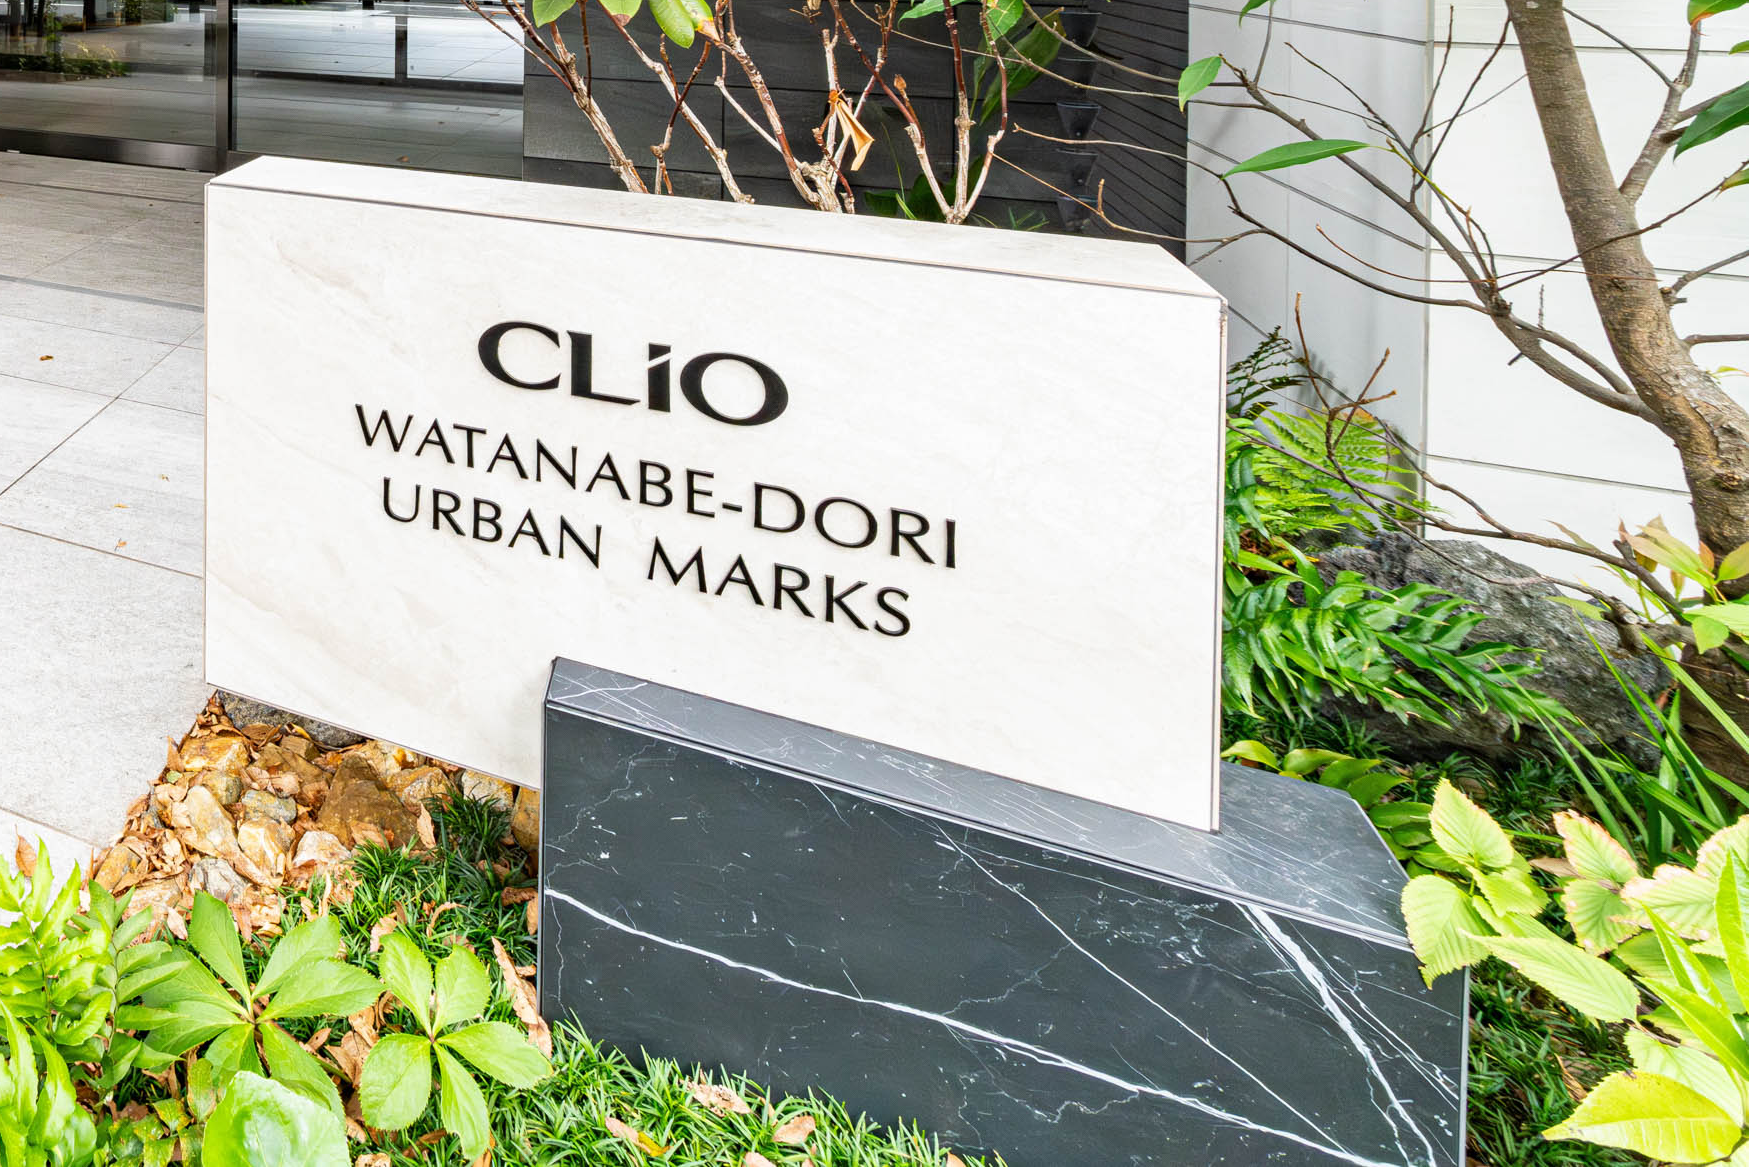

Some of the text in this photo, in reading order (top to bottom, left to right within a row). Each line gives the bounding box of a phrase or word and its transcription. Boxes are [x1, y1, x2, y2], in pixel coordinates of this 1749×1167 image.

[355, 403, 957, 569] WATANABE-DORI
[382, 477, 912, 637] URBAN MARKS
